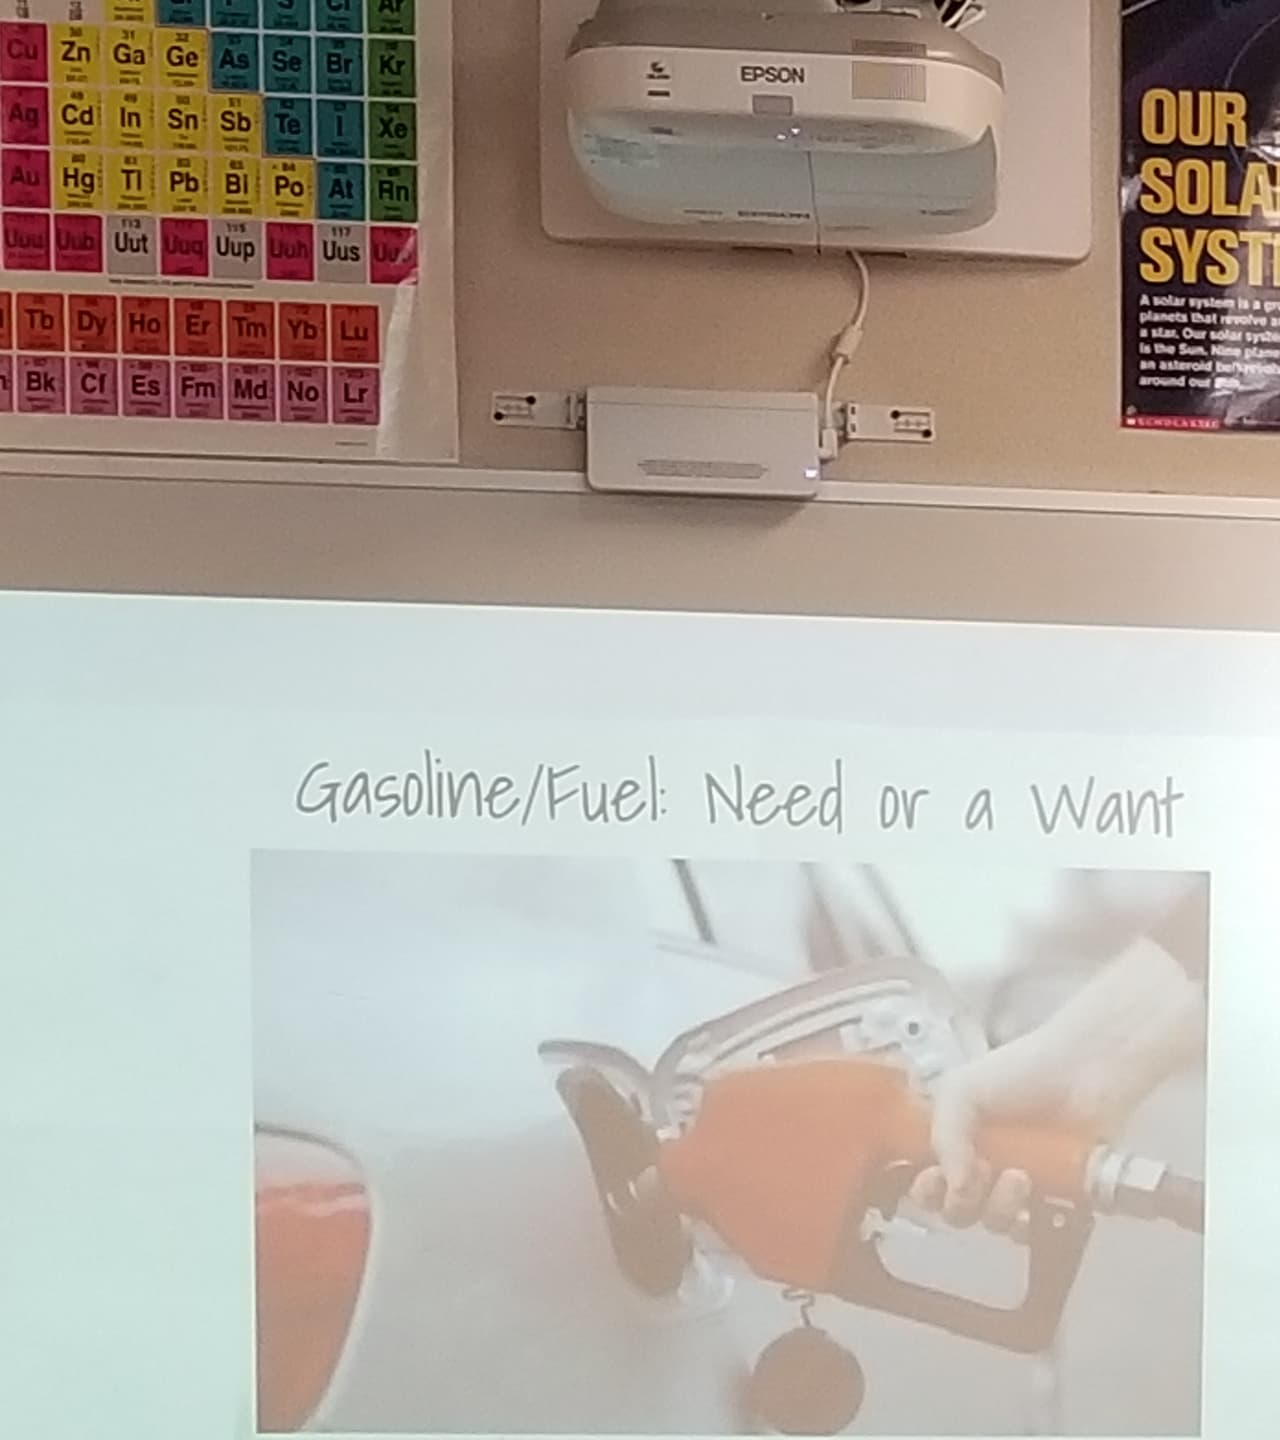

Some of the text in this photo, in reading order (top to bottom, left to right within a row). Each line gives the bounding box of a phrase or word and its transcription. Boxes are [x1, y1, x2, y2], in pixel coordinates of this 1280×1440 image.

[7, 38, 38, 60] Cu
[61, 40, 91, 63] Zn
[113, 43, 145, 65] Ga
[166, 46, 198, 67] Ge
[219, 49, 249, 70] As
[272, 50, 301, 72] Se
[327, 53, 352, 74] Br
[379, 54, 405, 75] Kr
[740, 65, 805, 84] EPSON
[9, 104, 39, 128] Ag
[62, 104, 94, 126] Cd
[120, 107, 141, 128] In
[168, 109, 198, 130] Sn
[220, 111, 251, 132] Sb
[274, 113, 301, 135] Te
[1141, 88, 1248, 148] OUR
[337, 116, 343, 137] I
[379, 117, 408, 139] Xe
[10, 166, 40, 186] Au
[63, 168, 94, 194] Hg
[121, 170, 141, 191] Tl
[169, 171, 199, 192] Pb
[225, 173, 248, 194] Bi
[275, 176, 304, 197] Po
[329, 178, 354, 199] At
[378, 180, 409, 201] Rn
[115, 231, 149, 254] Uut
[332, 227, 350, 237] 117
[216, 236, 255, 262] Uup
[322, 240, 361, 262] Uus
[1139, 294, 1150, 306] A
[1153, 294, 1185, 306] solar
[1189, 296, 1235, 310] system
[25, 308, 54, 330] Tb
[77, 310, 107, 336] Dy
[129, 312, 161, 333] Ho
[186, 314, 210, 336] Er
[232, 316, 267, 338] Tm
[288, 318, 318, 340] Yb
[1139, 311, 1188, 324] planets
[1191, 312, 1218, 324] that
[1220, 313, 1268, 326] revolve
[340, 320, 369, 341] Lu
[1151, 327, 1179, 339] star.
[1182, 328, 1207, 340] Our
[1210, 330, 1243, 341] solar
[1139, 343, 1151, 354] is
[1154, 343, 1175, 355] the
[1179, 343, 1208, 356] Sun.
[1211, 345, 1241, 357] Nine
[1140, 360, 1156, 370] an
[1159, 359, 1213, 371] asteroid
[26, 370, 56, 392] Bk
[80, 373, 107, 394] Cf
[131, 374, 161, 396] Es
[181, 376, 216, 398] Fm
[234, 378, 268, 400] Md
[287, 380, 319, 402] No
[1139, 376, 1186, 387] around
[343, 382, 369, 403] Lr
[294, 748, 1185, 838] Gasoline/Fuel: Need or a Want
